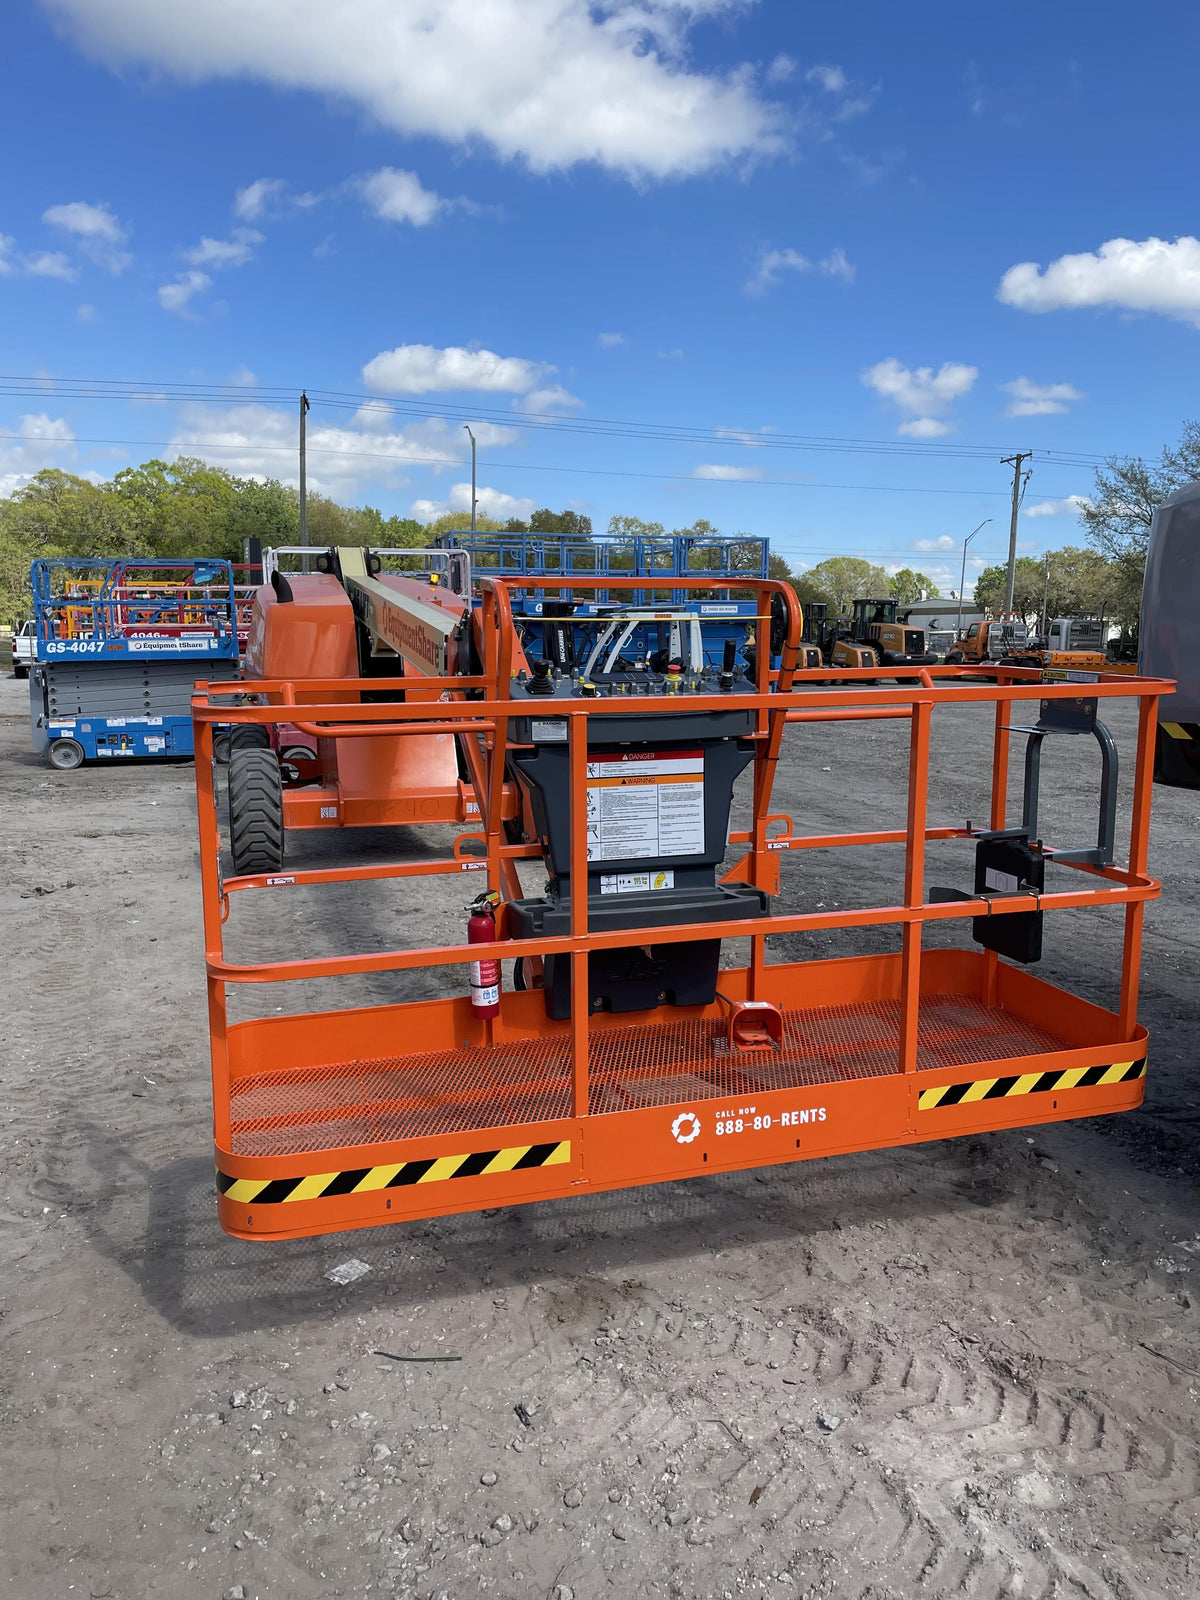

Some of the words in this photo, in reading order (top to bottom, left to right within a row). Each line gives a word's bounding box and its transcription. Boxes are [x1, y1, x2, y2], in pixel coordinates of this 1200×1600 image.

[46, 641, 105, 654] GS-4047
[628, 752, 655, 760] DANGER
[627, 777, 656, 785] WARNING
[715, 1110, 735, 1119] CALL
[739, 1106, 757, 1115] NOW
[715, 1107, 827, 1136] 888-80-RENTS
